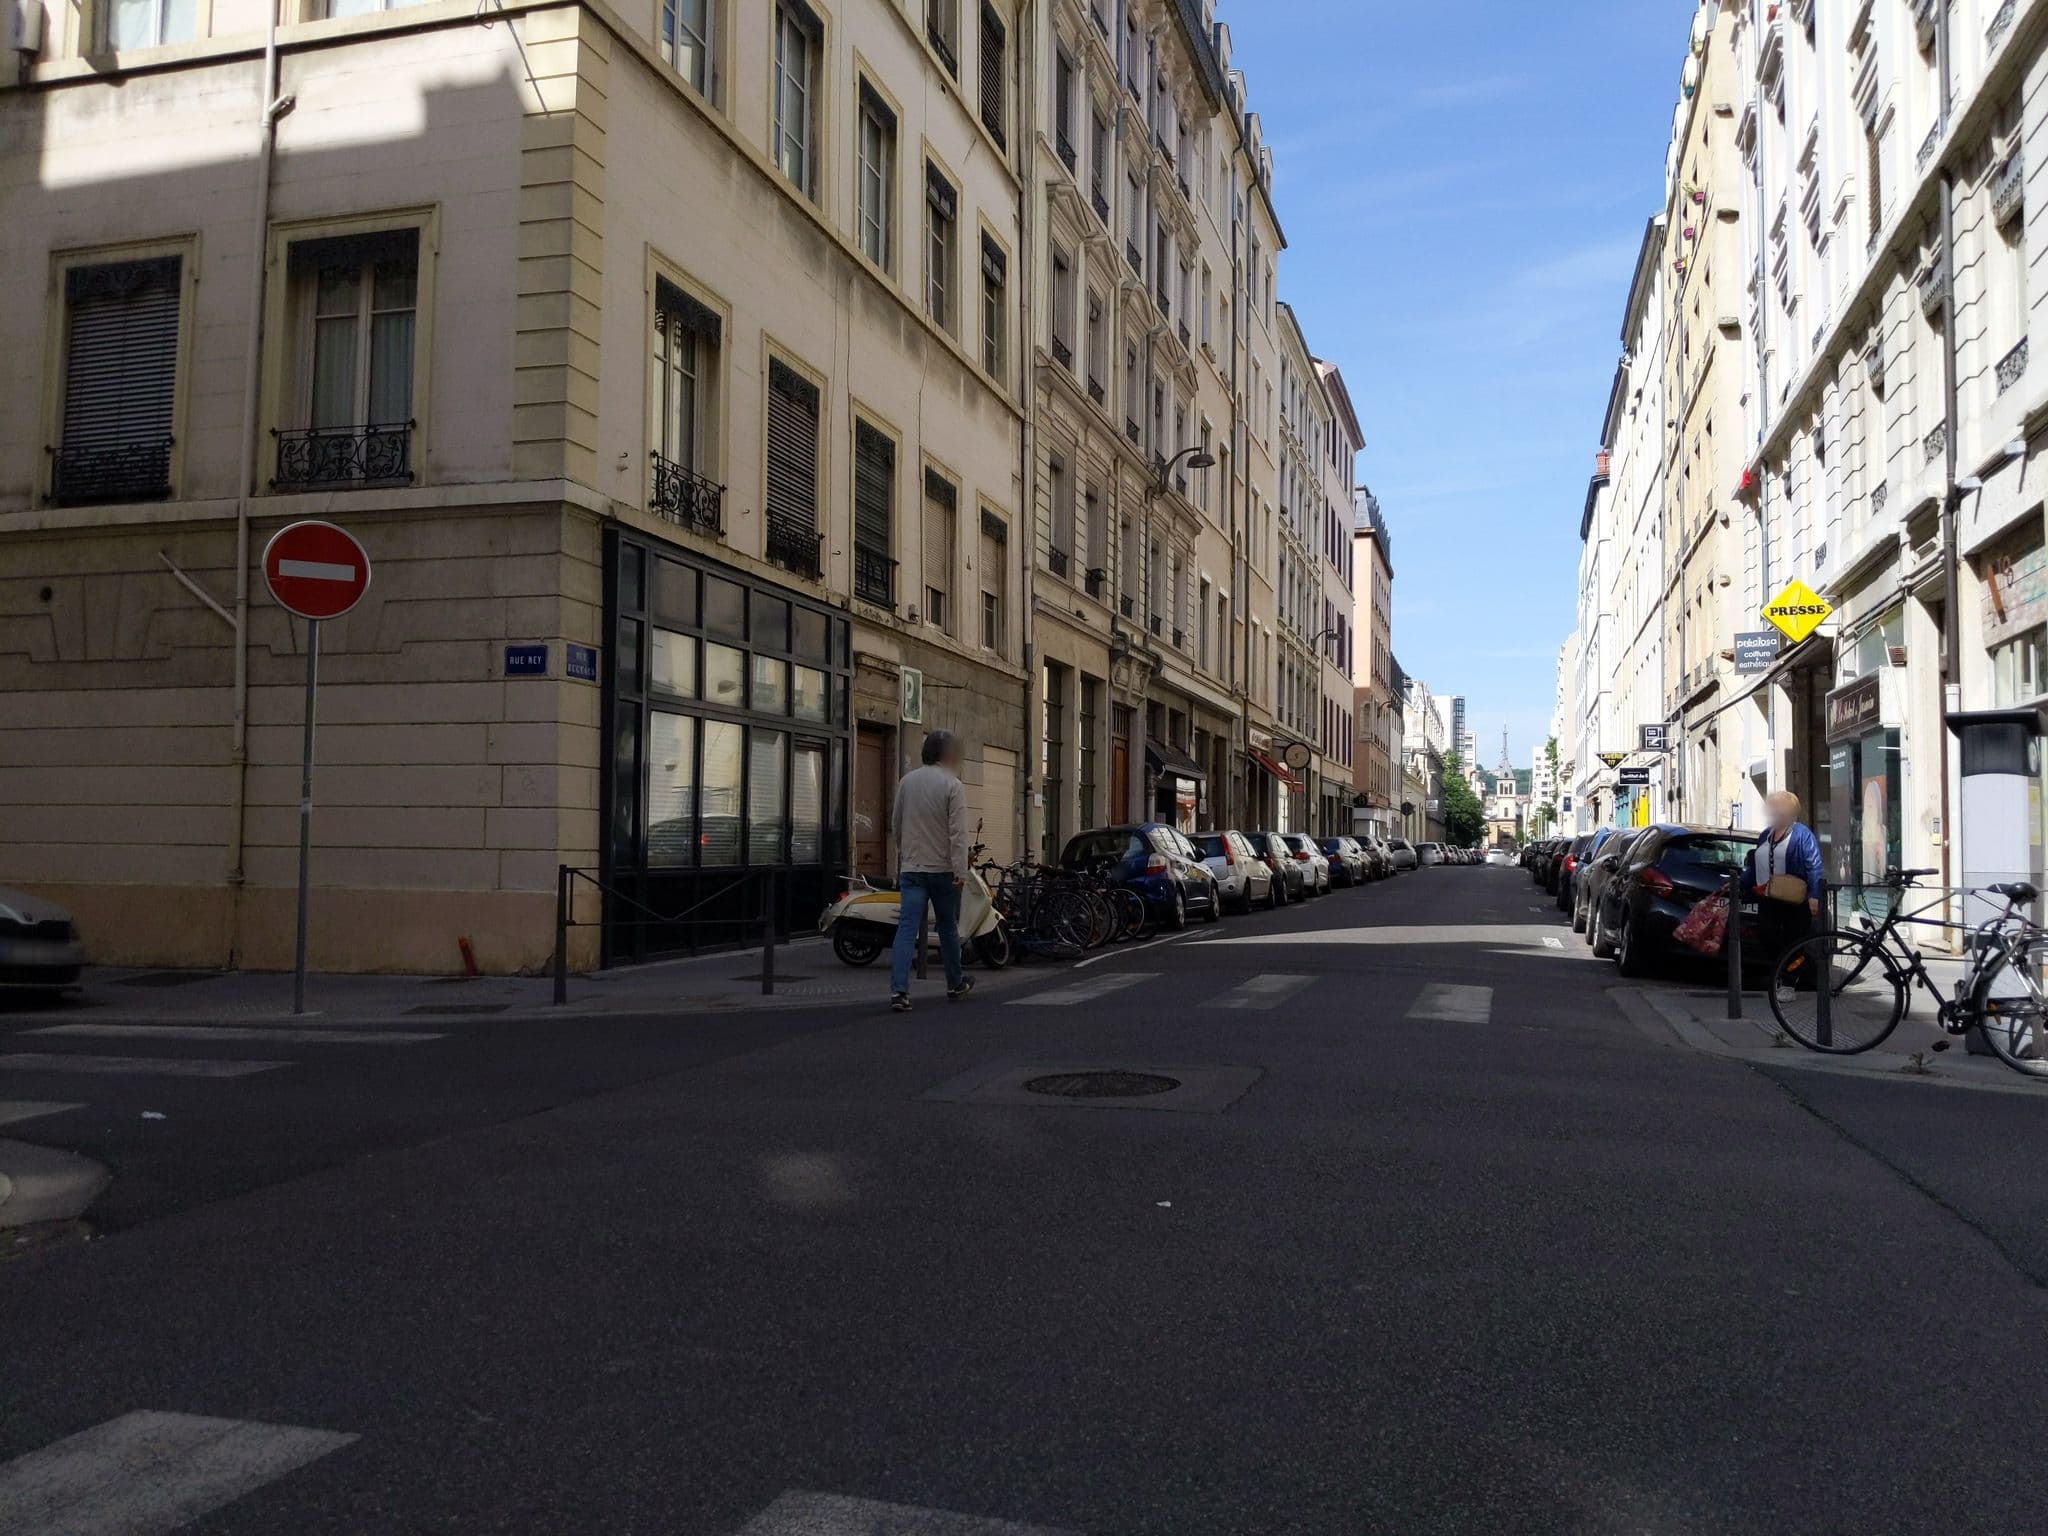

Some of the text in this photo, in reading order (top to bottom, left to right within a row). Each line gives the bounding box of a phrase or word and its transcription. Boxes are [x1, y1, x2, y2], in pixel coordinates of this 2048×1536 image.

[1769, 605, 1826, 617] PRESSE
[1736, 637, 1777, 649] préciosa
[509, 656, 542, 665] RUE NEY
